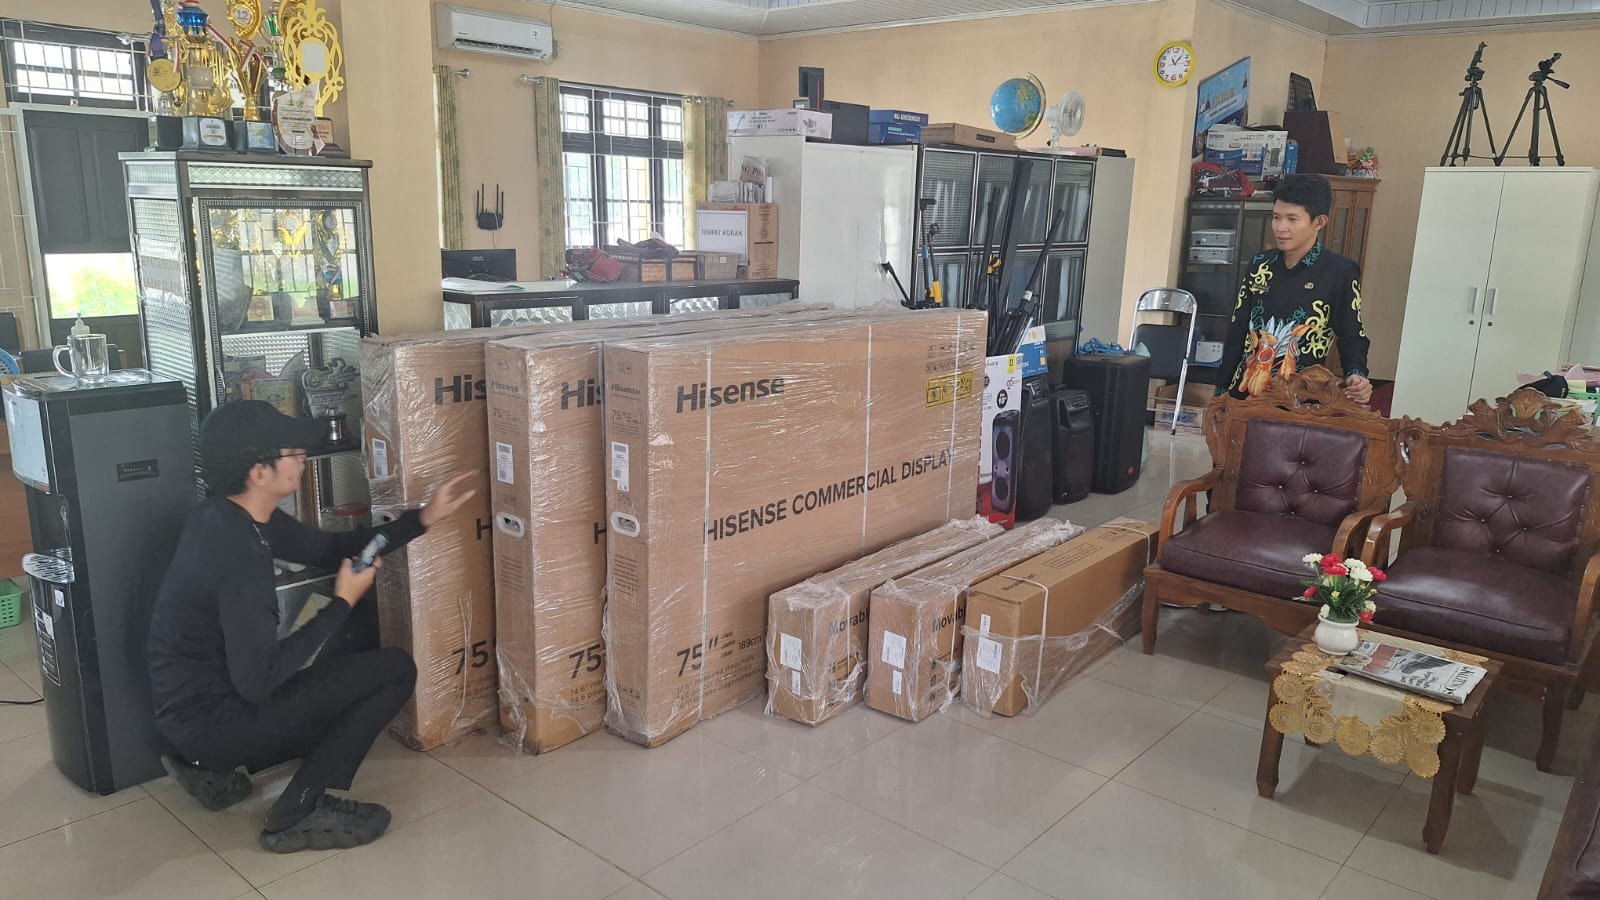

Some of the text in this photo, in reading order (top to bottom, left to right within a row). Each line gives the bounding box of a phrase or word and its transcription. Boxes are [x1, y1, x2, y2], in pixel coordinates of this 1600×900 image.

[701, 228, 743, 237] TEMPAT KORAN
[676, 377, 785, 413] Hisense
[702, 498, 788, 545] HISENSE
[792, 466, 898, 515] COMMERCIAL
